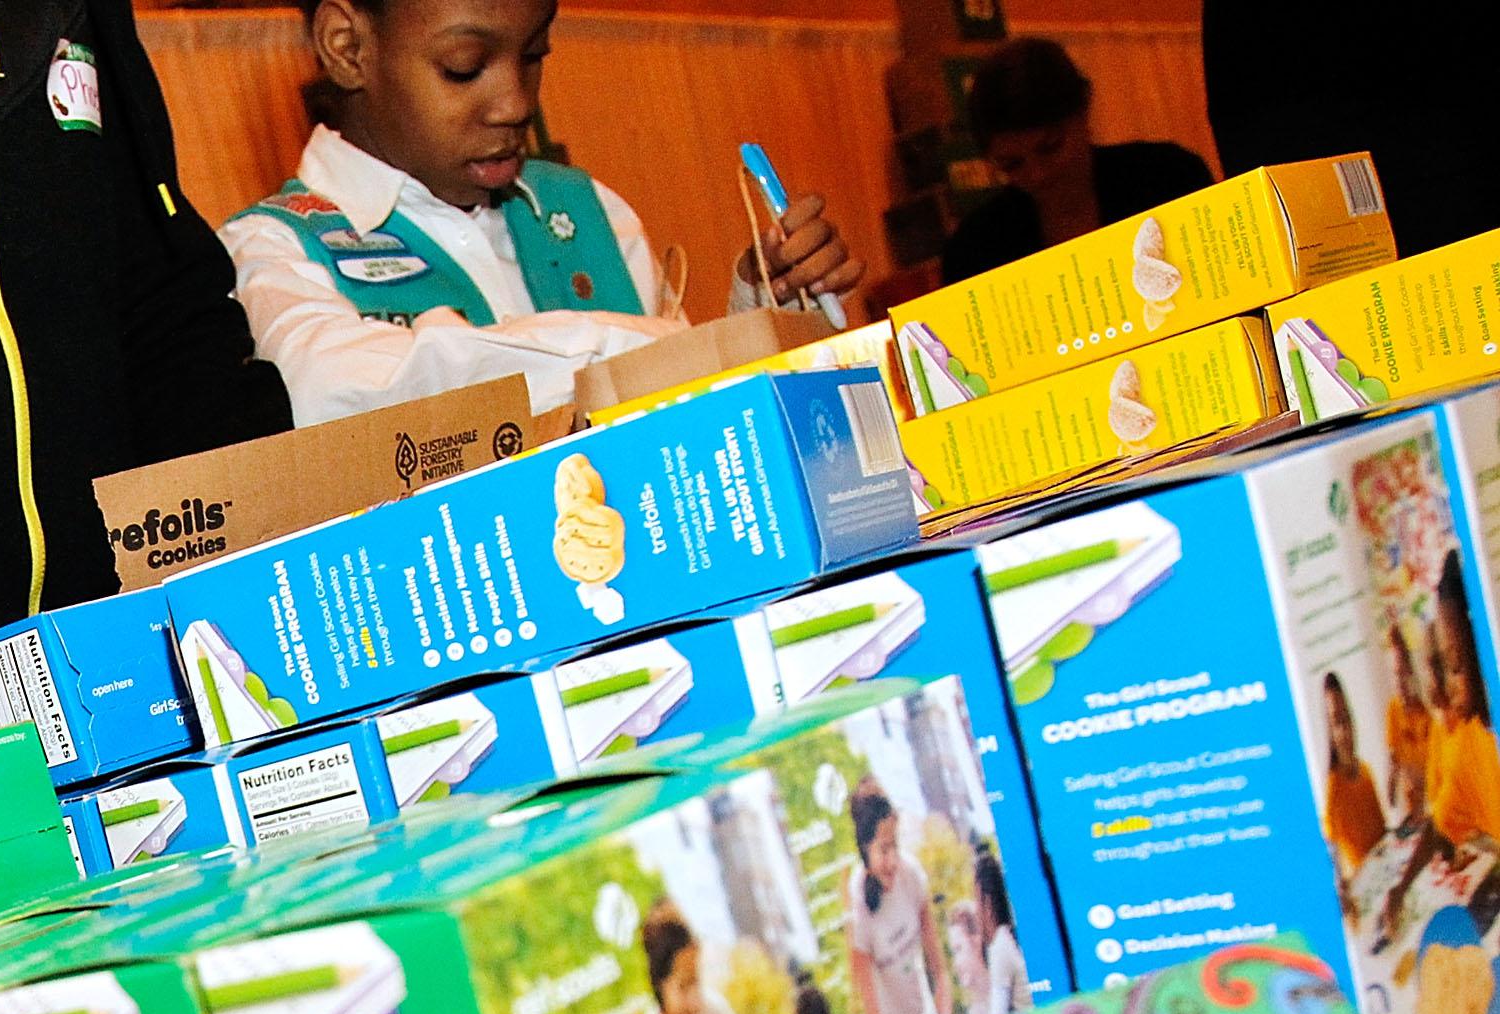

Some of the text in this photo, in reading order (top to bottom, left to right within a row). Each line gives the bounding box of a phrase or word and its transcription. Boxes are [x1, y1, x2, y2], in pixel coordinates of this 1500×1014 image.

[1369, 278, 1400, 384] COOKIE PROGRAM
[1478, 318, 1490, 342] Goal
[418, 429, 478, 456] SUSTAINABLE
[420, 447, 463, 469] FORESTRY
[421, 461, 465, 481] INITIATIVE
[698, 494, 717, 532] Thank
[713, 448, 747, 541] TELL US YOUR
[733, 474, 757, 523] SCOUT
[148, 535, 227, 569] Cookies
[745, 521, 765, 556] GIRL
[341, 552, 354, 575] use
[437, 501, 480, 634] Money Management
[472, 541, 505, 627] People Skills
[491, 513, 528, 619] Business Ethics
[345, 573, 362, 602] they
[362, 574, 378, 603] their
[401, 565, 432, 648] Goal Setting
[418, 533, 455, 641] Decision Making
[272, 558, 320, 706] COOKIE PROGRAM
[306, 551, 351, 689] Selling Girl Scout Cookies
[326, 564, 362, 667] helps girls develop
[353, 601, 366, 626] that
[369, 601, 396, 667] throughout
[267, 594, 296, 676] The Girl Scout
[358, 624, 376, 660] skills
[24, 634, 73, 758] Nutrition Facts
[92, 678, 134, 697] open here
[149, 699, 167, 716] Girl
[242, 749, 350, 791] Nutrition Facts
